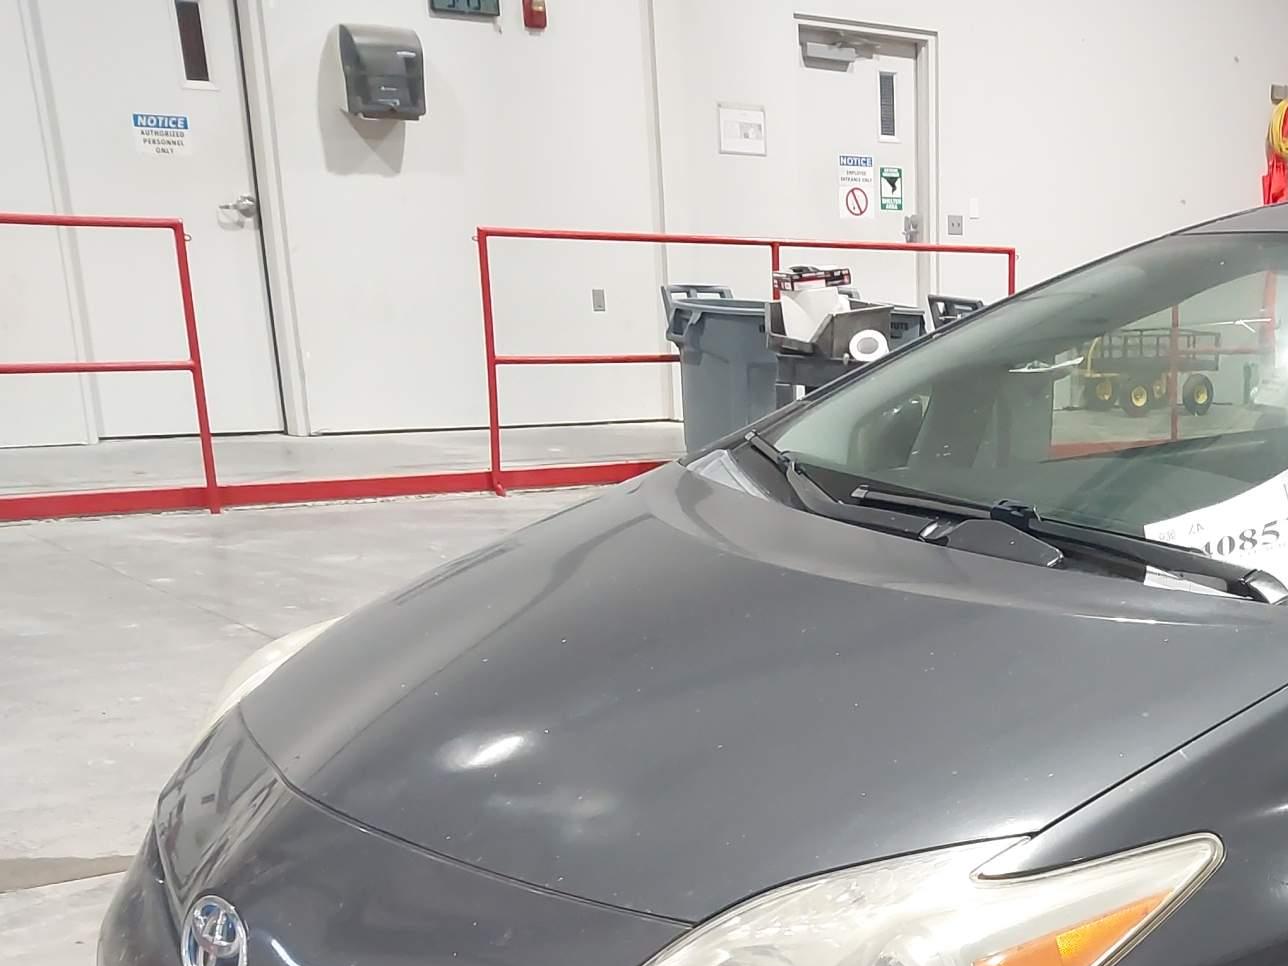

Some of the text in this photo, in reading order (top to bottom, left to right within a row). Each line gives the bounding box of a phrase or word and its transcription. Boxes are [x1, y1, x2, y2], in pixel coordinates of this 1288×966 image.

[137, 115, 185, 128] NOTICE
[140, 130, 185, 138] AUTHORIZED
[142, 138, 185, 146] PERSONNEL
[840, 156, 872, 167] NOTICE
